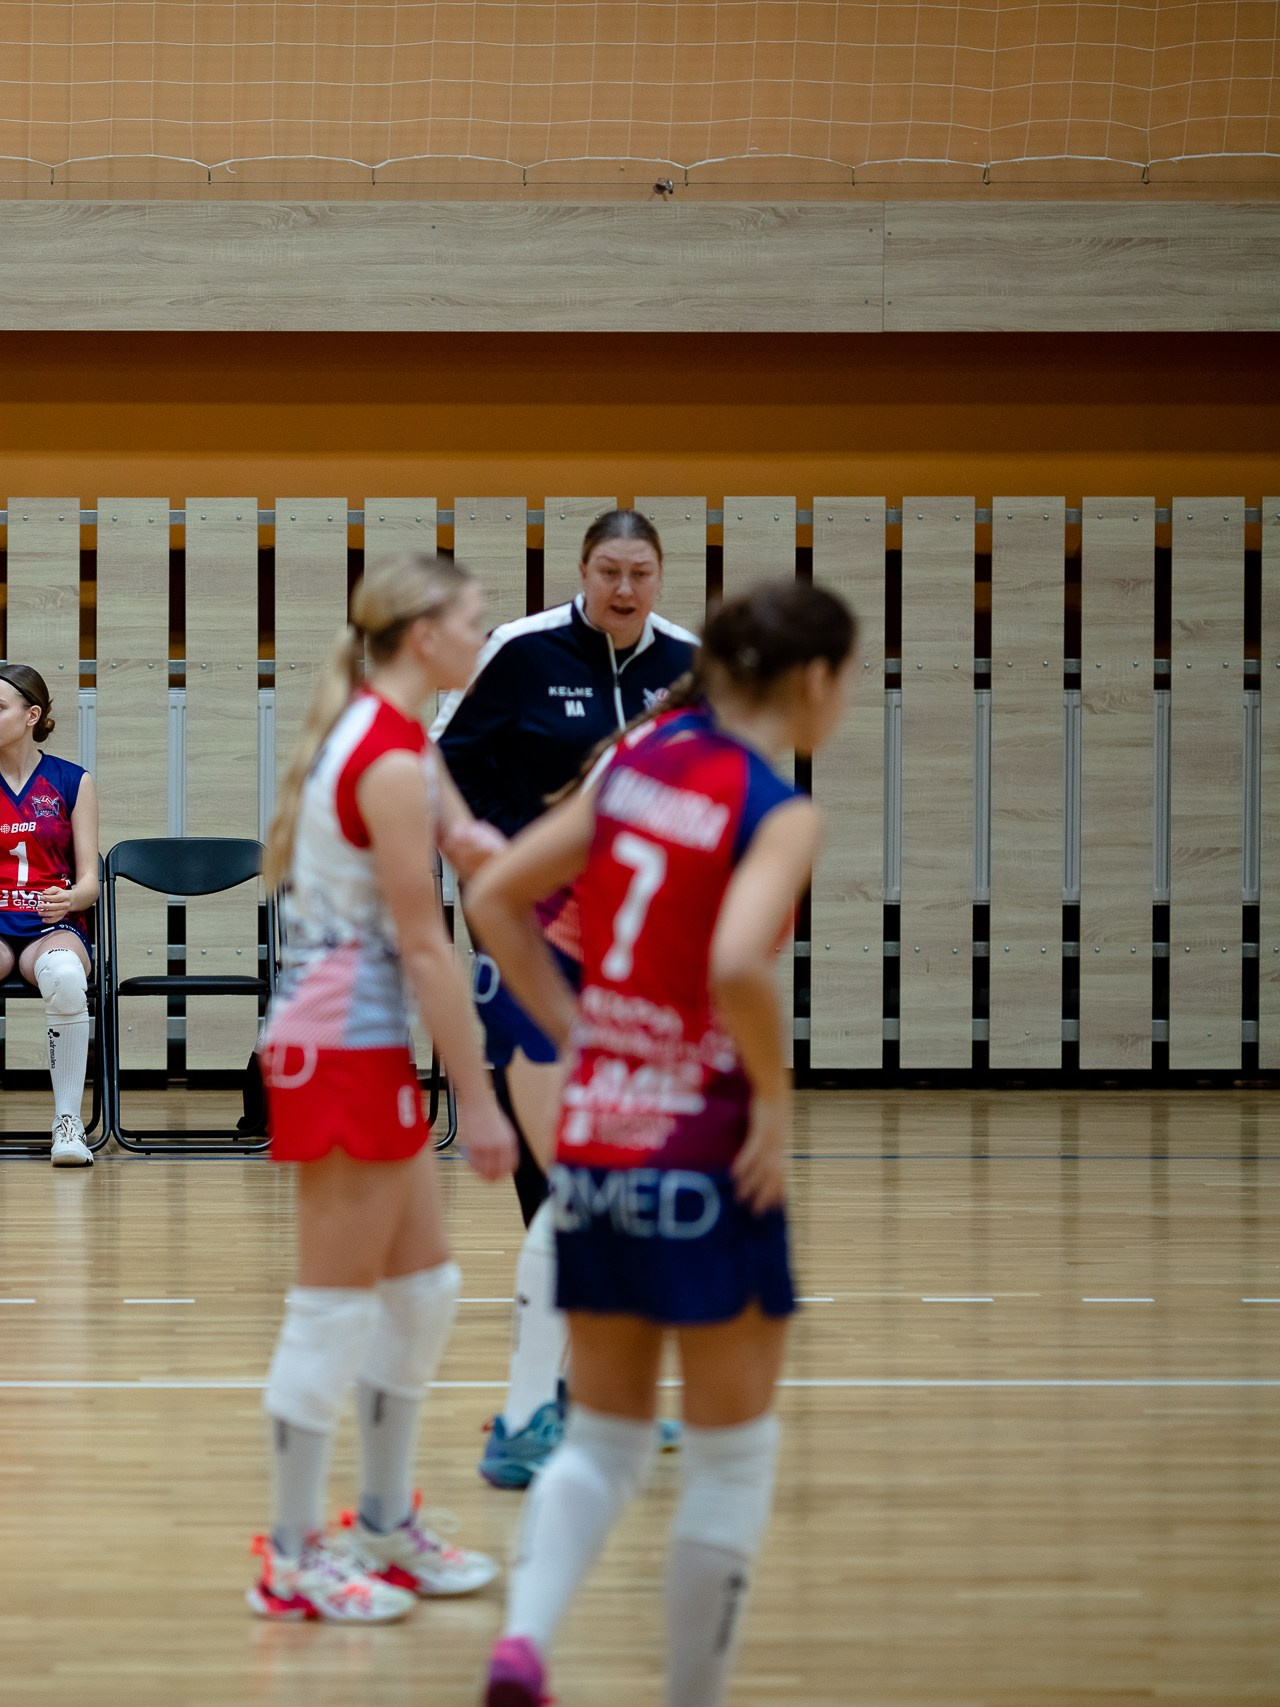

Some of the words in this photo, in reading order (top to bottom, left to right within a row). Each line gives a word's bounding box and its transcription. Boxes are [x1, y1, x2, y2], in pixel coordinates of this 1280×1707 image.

[548, 686, 593, 698] KELME
[9, 841, 29, 887] 1
[600, 830, 668, 983] 7
